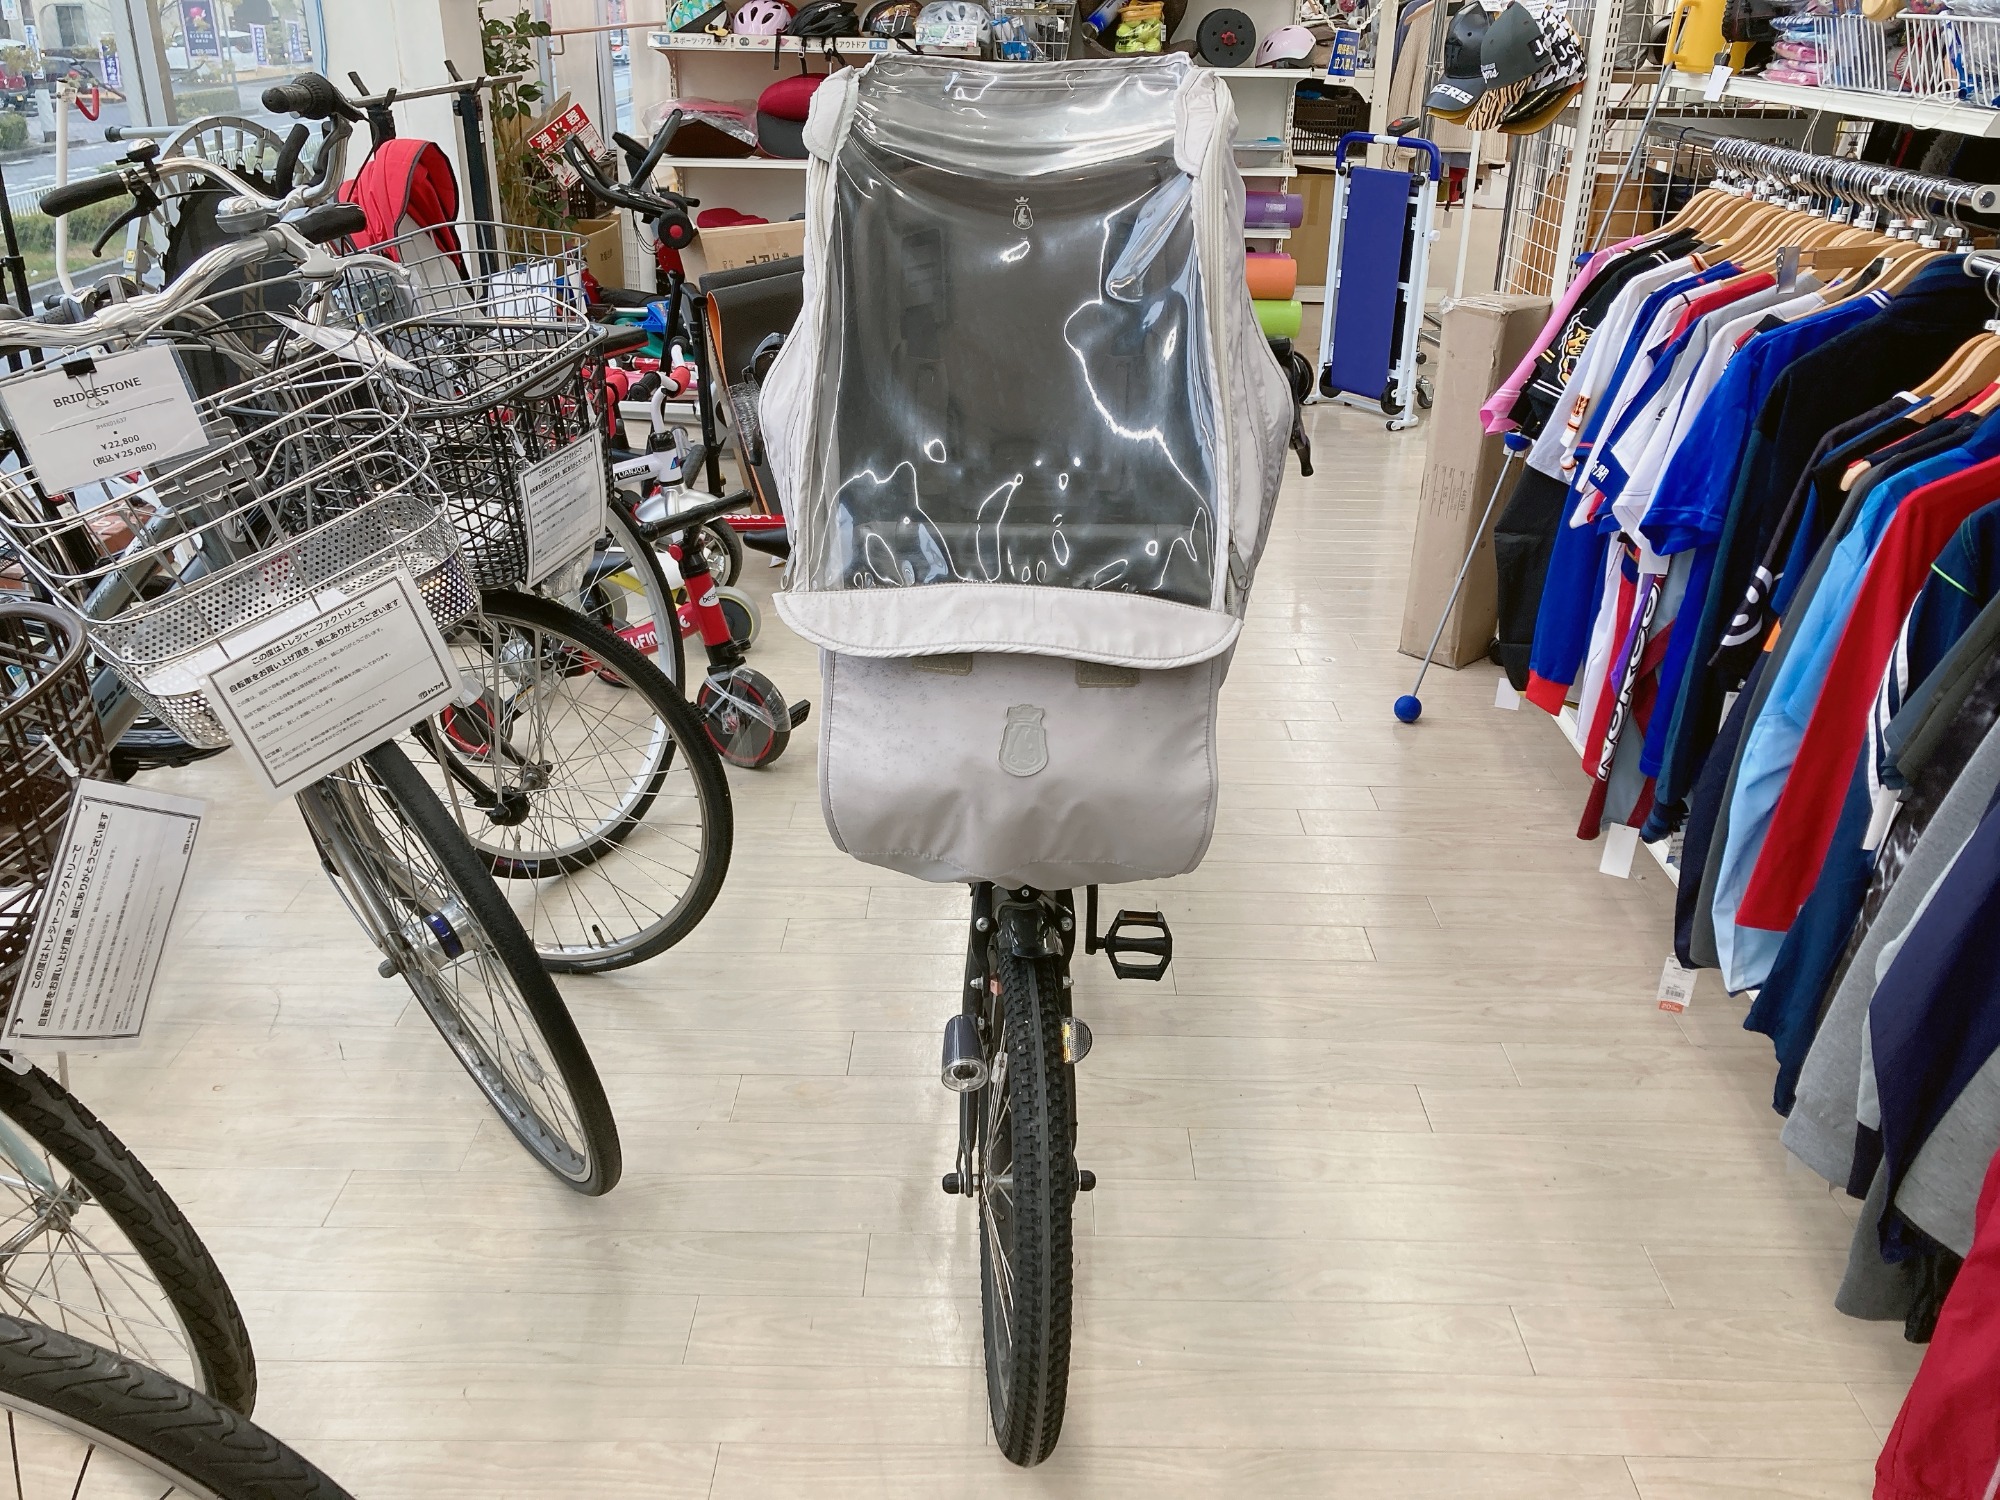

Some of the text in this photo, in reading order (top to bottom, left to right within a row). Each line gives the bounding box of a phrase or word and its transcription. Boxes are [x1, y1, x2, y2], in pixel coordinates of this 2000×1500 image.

[673, 37, 728, 46] スポーツ・アウア
[535, 109, 581, 149] 消火器
[53, 376, 142, 408] BRIDGESTONE
[228, 597, 400, 694] 自転車をお買い上げ頂き、誠にありがとうございます
[250, 599, 366, 665] この度はトレジャーファクトリーで
[29, 843, 82, 988] この度はトレジャーファクトリーで
[37, 811, 110, 1026] 自転車をお買い上げ頂き、誠にありがとうございます
